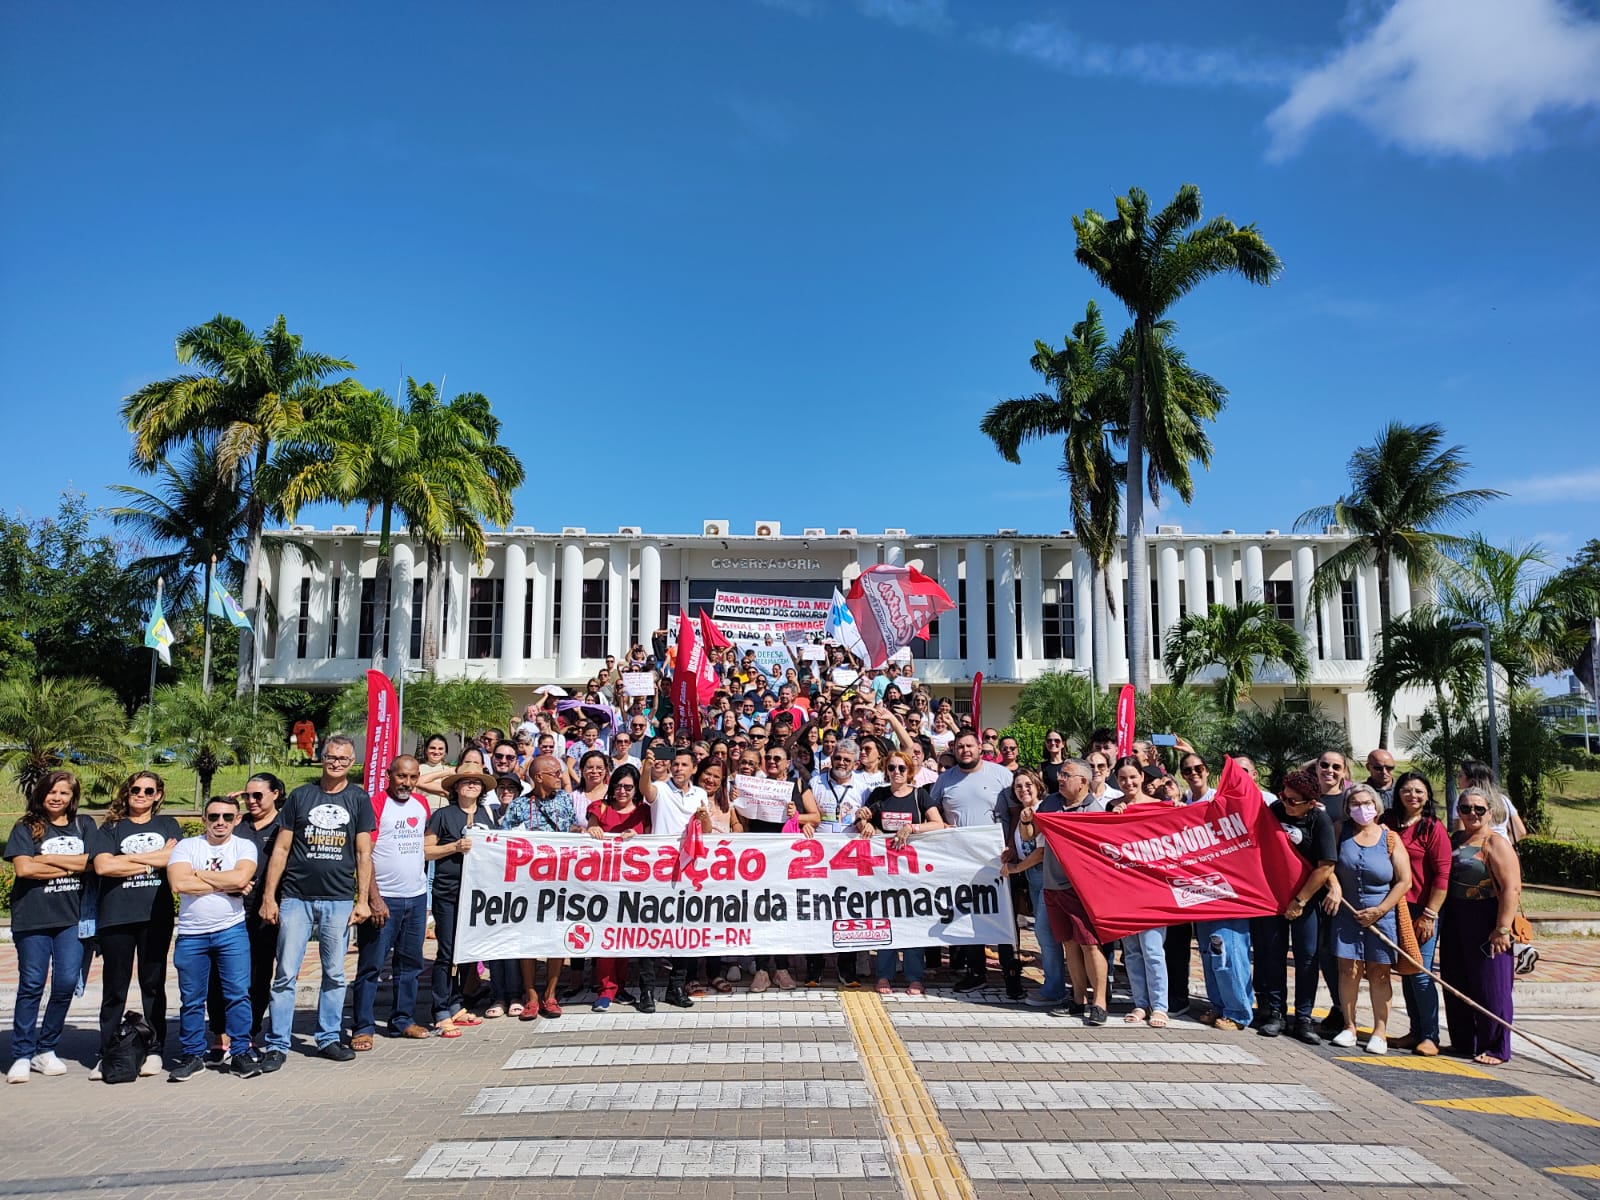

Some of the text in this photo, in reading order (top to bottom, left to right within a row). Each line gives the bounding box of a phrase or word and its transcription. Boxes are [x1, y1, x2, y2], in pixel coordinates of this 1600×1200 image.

[717, 594, 740, 604] PARA
[742, 596, 749, 604] O
[750, 597, 794, 609] HOSPITAL
[797, 600, 811, 610] DA
[715, 604, 771, 616] CONVOCAÇÃO
[773, 608, 788, 618] DOS
[758, 622, 772, 632] DA
[775, 620, 825, 632] ENFERMAGE
[757, 650, 784, 658] DEFESA
[307, 834, 346, 846] DIREITO
[1121, 812, 1248, 862] SINDSAÚDE-RN
[317, 844, 342, 853] Menos
[470, 889, 529, 927] Pelo
[536, 887, 609, 923] Piso
[617, 889, 748, 923] Nacional
[753, 888, 788, 922] da
[835, 920, 887, 931] CSP
[601, 926, 751, 950] SINDSAÚDE-RN
